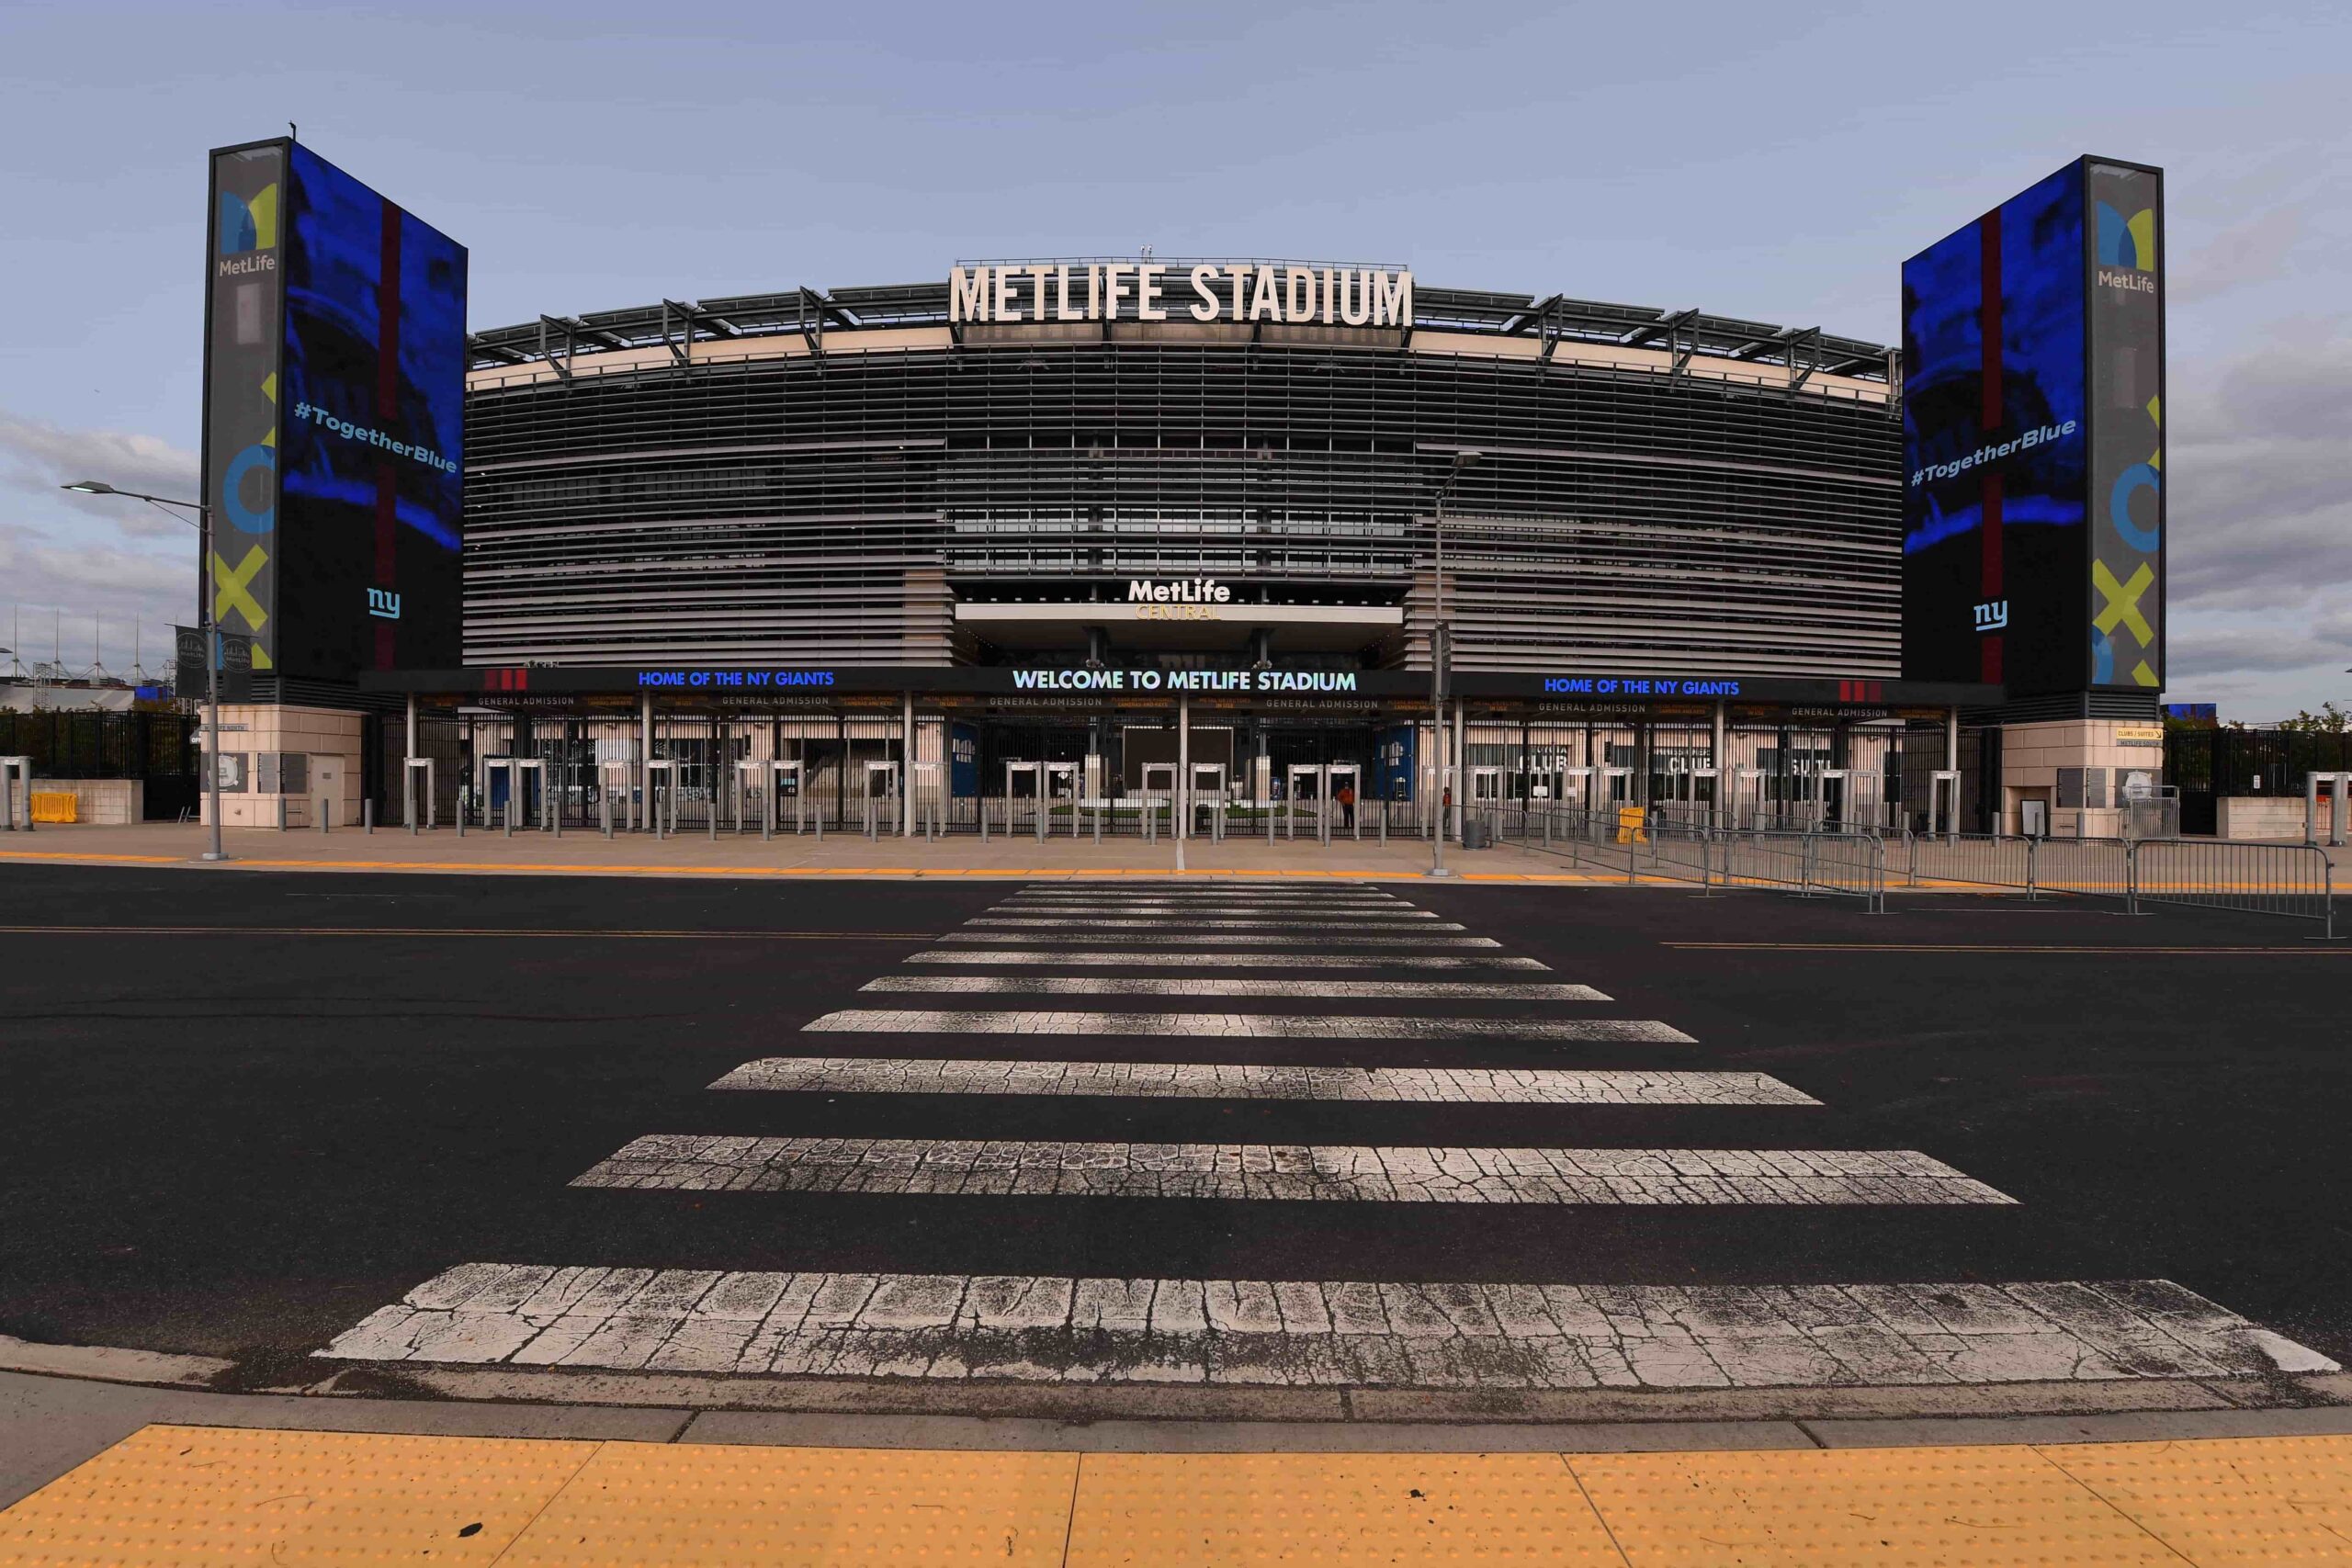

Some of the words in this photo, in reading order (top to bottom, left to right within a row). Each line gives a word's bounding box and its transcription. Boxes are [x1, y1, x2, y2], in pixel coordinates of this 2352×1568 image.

[219, 254, 276, 276] MetLife
[2098, 270, 2154, 294] MetLife
[950, 265, 1167, 321] METLIFE
[1190, 265, 1413, 327] STADIUM
[294, 401, 458, 473] #TogetherBlue
[1911, 419, 2076, 487] #TogetherBlue
[1127, 578, 1230, 603] MetLife
[1136, 604, 1222, 621] CENTRAL
[639, 671, 685, 686] HOME
[689, 671, 710, 686] OF
[715, 671, 742, 686] THE
[747, 671, 771, 686] NY
[775, 671, 834, 686] GIANTS
[1012, 670, 1124, 689] WELCOME
[1129, 671, 1161, 690] TO
[1167, 671, 1251, 690] METLIFE
[1257, 671, 1357, 692] STADIUM
[1544, 679, 1592, 693] HOME
[1596, 680, 1618, 694] OF
[1622, 680, 1650, 694] THE
[1655, 681, 1679, 694] NY
[1682, 681, 1739, 695] GIANTS
[478, 697, 520, 705] GENERAL
[523, 696, 574, 705] ADMISSION
[722, 697, 769, 705] GENERAL
[772, 696, 829, 705] ADMISSION
[989, 697, 1039, 706] GENERAL
[1042, 697, 1102, 706] ADMISSION
[1266, 699, 1316, 708] GENERAL
[1318, 700, 1379, 709] ADMISSION
[1538, 703, 1587, 712] GENERAL
[1589, 704, 1645, 714] ADMISSION
[1792, 707, 1835, 716] GENERAL
[1837, 708, 1888, 718] ADMISSION
